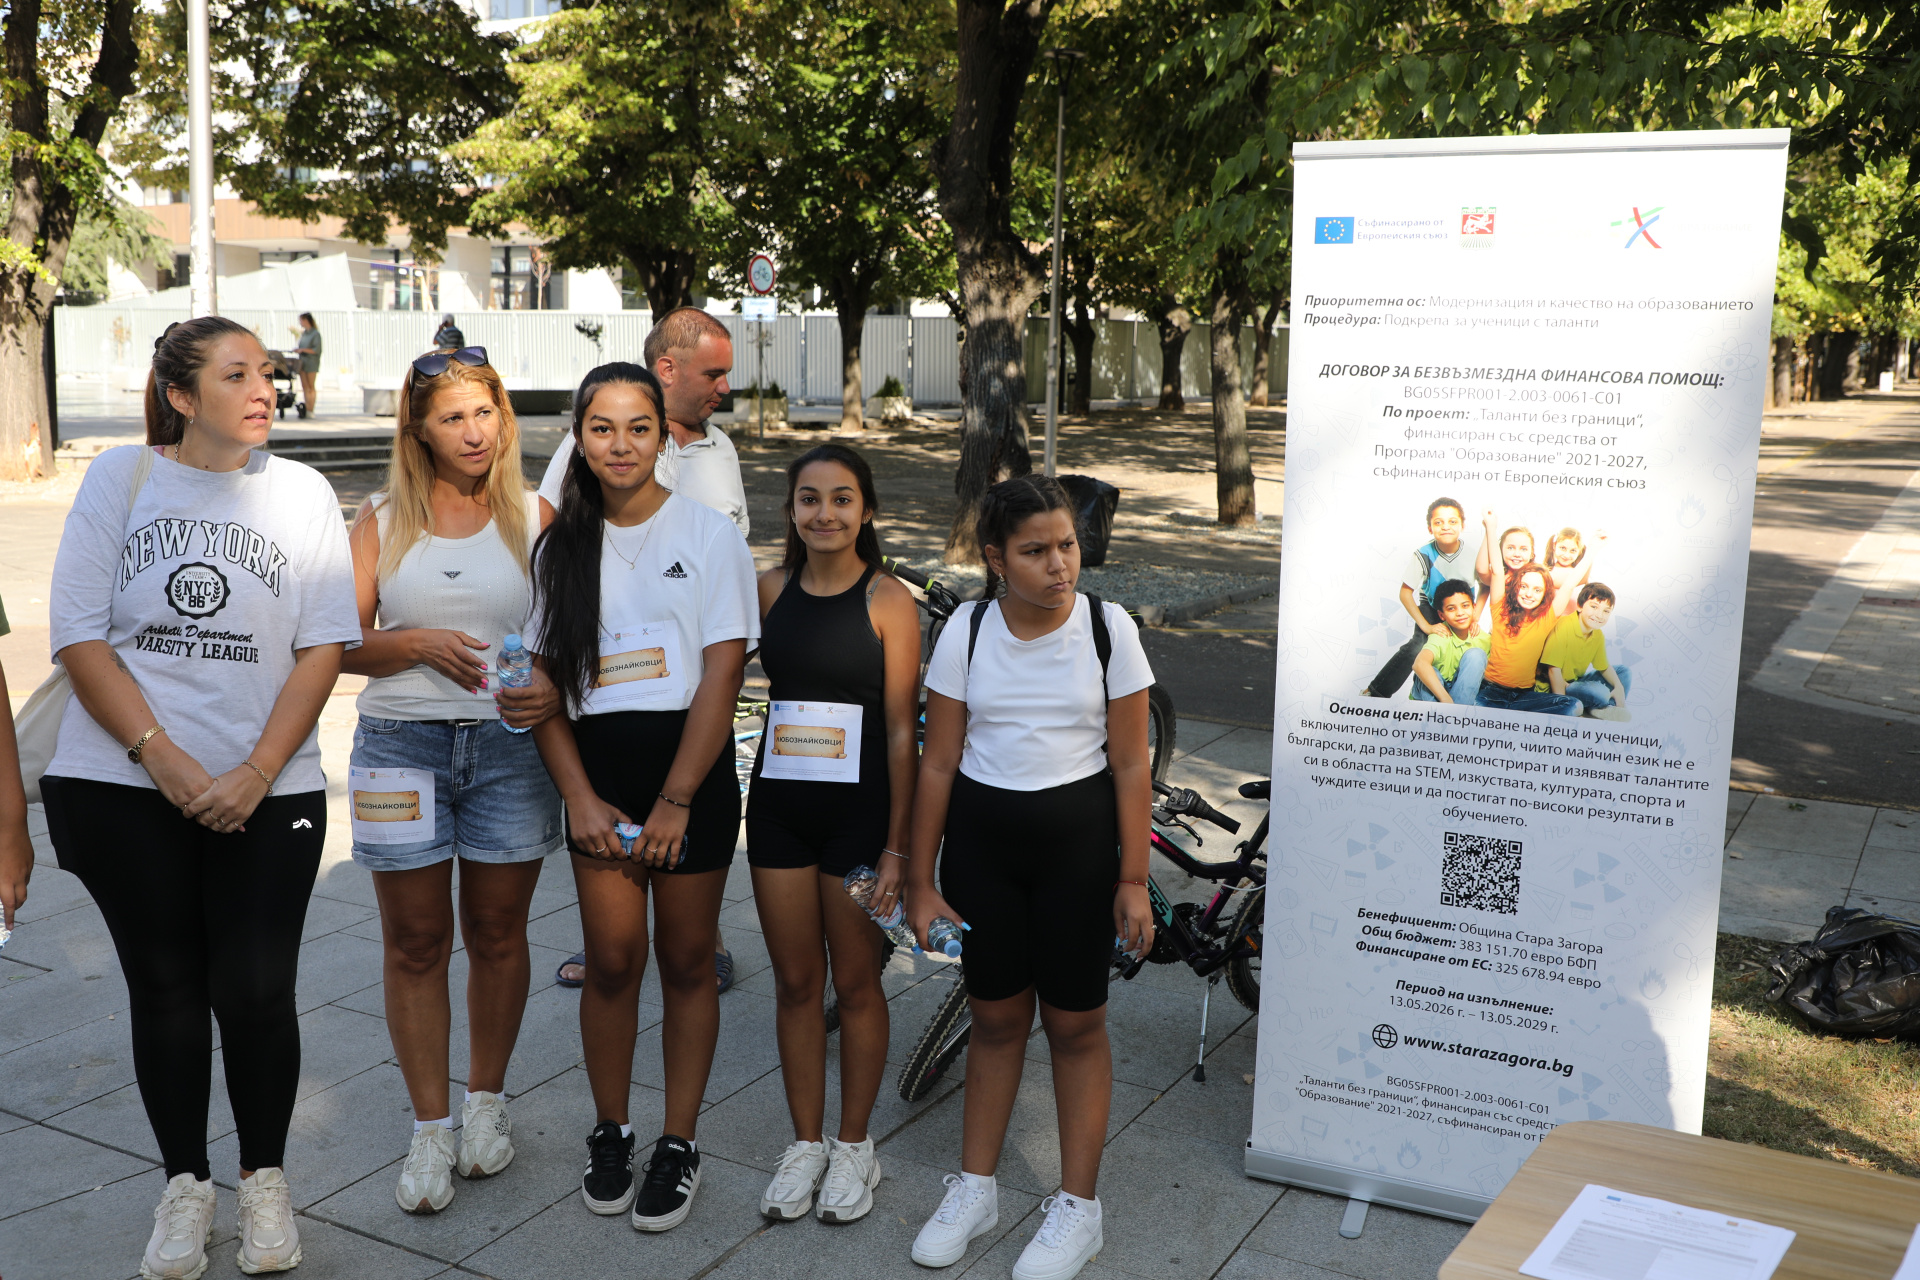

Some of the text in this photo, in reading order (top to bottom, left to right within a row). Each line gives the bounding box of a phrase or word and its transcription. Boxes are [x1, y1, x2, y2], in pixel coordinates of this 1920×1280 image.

[1304, 294, 1404, 308] Приоритетна
[1406, 298, 1426, 306] ос:
[1430, 296, 1534, 310] Модернизация
[1550, 299, 1614, 309] качество
[1618, 300, 1634, 309] на
[1638, 297, 1754, 312] образованието
[1304, 313, 1599, 329] Процедура: Подкрепа за ученици с таланти
[1318, 364, 1725, 390] ДОГОВОР ЗА БЕЗВЪЗМЕЗДНА ФИНАНСОВА ПОМОЩ:
[1404, 386, 1621, 405] BG05SFPR001-2.003-0061-C01
[1382, 405, 1403, 418] По
[1405, 409, 1471, 421] проект:
[1542, 410, 1567, 424] без
[1404, 425, 1618, 447] финансиран със средства от
[1374, 444, 1647, 470] Програма "Образование" 2021-2027,
[1372, 465, 1646, 490] съфинансиран от Европейския съюз
[121, 518, 287, 597] NEW YORK
[183, 580, 212, 596] NYC
[188, 595, 206, 608] 86
[135, 636, 258, 664] VARSITY LEAGUE
[185, 625, 253, 643] Department
[1329, 702, 1662, 750] Основна цел: Насърчаване на деца и ученици,
[1287, 732, 1710, 791] български, да развиват, демонстрират и изявяват талантите
[1300, 719, 1695, 771] включително от уязвими групи, чиито майчин език не е
[1303, 756, 1685, 809] си в областта на STEM, изкуствата, културата, спорта и
[1311, 775, 1674, 827] чуждите езици и да постигат по-високи резултати в
[1442, 805, 1527, 827] обучението.
[1357, 908, 1603, 955] Бенефициент: Община Стара Загора
[1362, 924, 1597, 970] Общ бюджет: 383 151.70 евро БФП
[1356, 941, 1602, 990] Финансиране от ЕС: 325 678.94 евро
[1389, 995, 1455, 1016] 13.05.2026
[1457, 1009, 1465, 1018] г.
[1480, 1010, 1548, 1032] 13.05.2029
[1550, 1025, 1559, 1033] г.
[1395, 979, 1554, 1015] Период на изпълнение:
[1403, 1036, 1574, 1077] www.starazagora.bg
[1347, 1082, 1366, 1094] без
[1421, 1097, 1491, 1118] финансиран
[1493, 1112, 1514, 1123] със
[1515, 1116, 1559, 1130] средст
[1386, 1075, 1549, 1114] BG05SFPR001-2.003-0061-C01
[1293, 1088, 1375, 1110] "Образование"
[1376, 1102, 1435, 1124] 2021-2027,
[1437, 1116, 1521, 1138] съфинансиран
[1523, 1132, 1537, 1142] от
